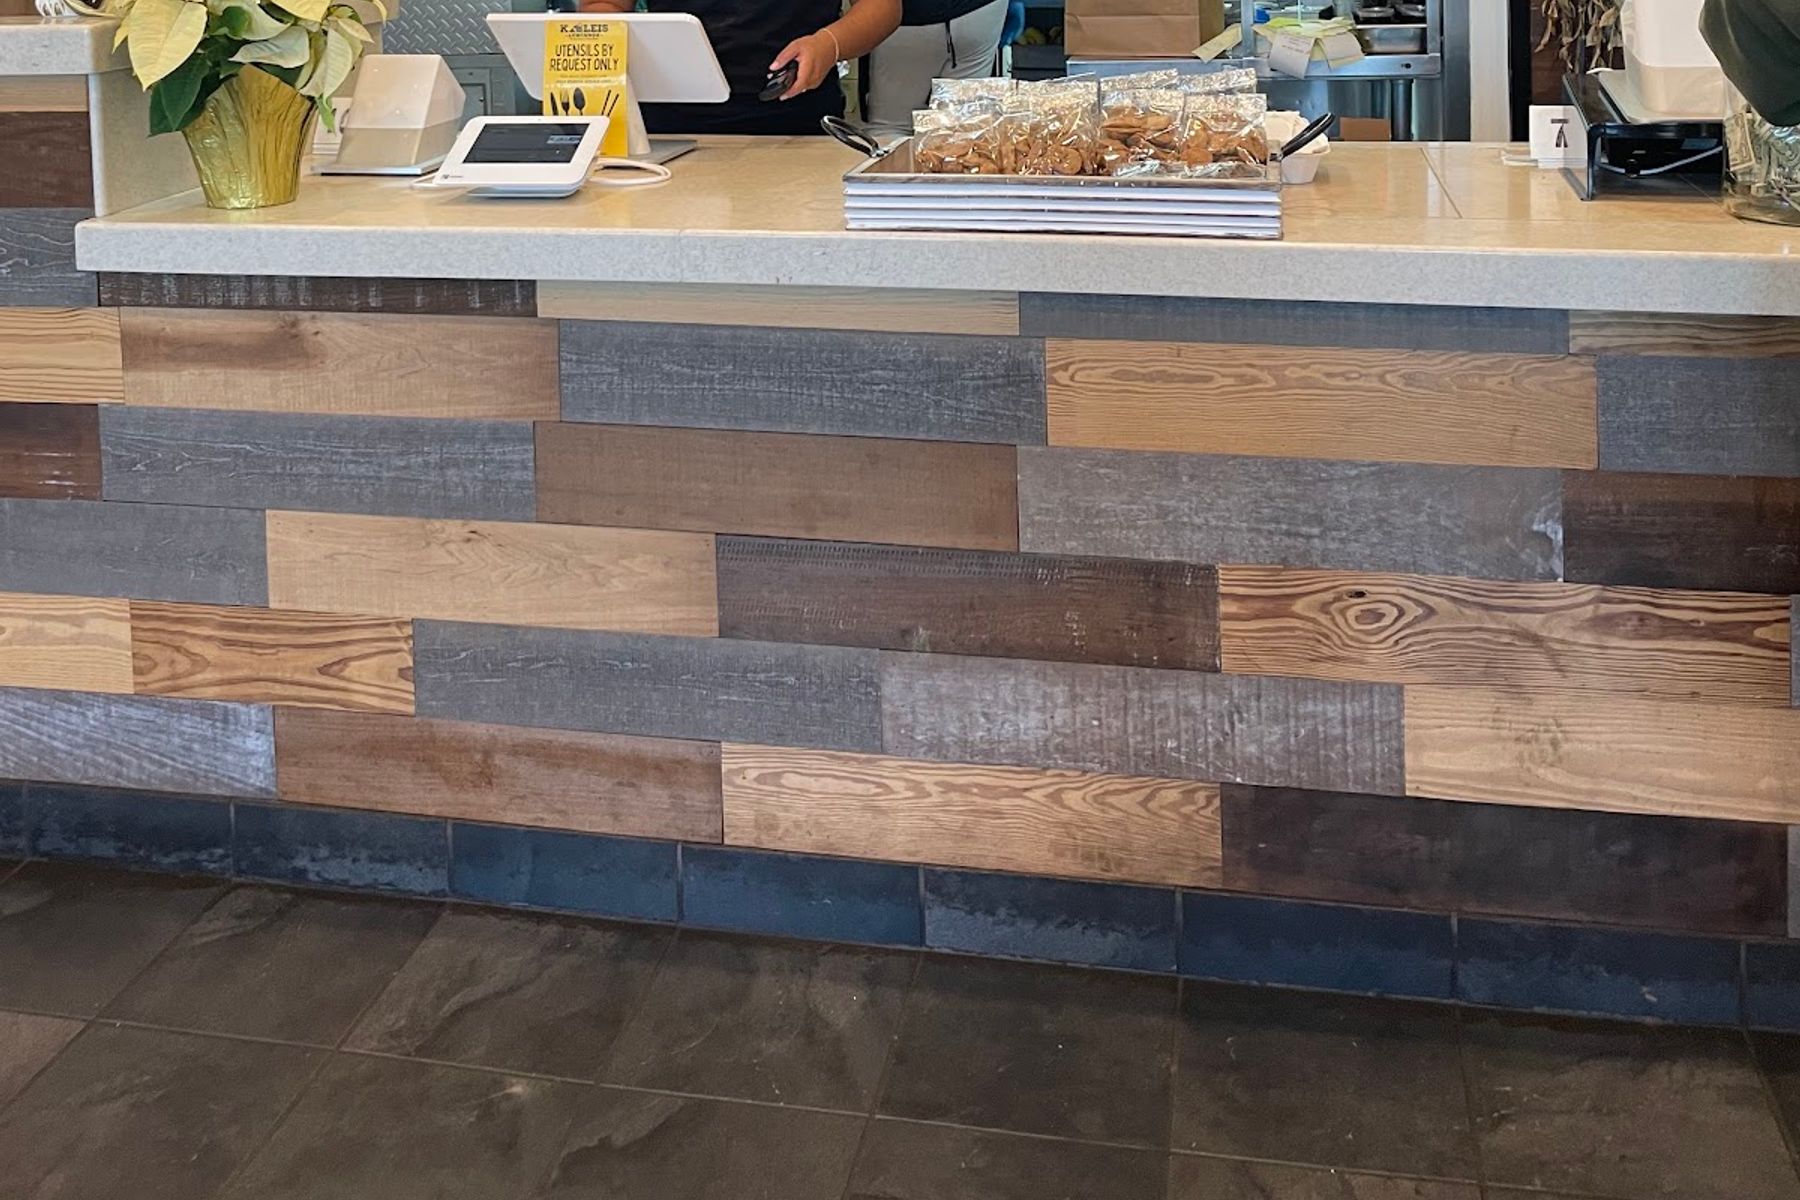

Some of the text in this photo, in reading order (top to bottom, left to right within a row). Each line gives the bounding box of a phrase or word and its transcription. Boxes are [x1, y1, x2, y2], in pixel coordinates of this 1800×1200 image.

[555, 43, 614, 57] UTENSILS BY
[549, 58, 619, 71] REQUEST ONLY
